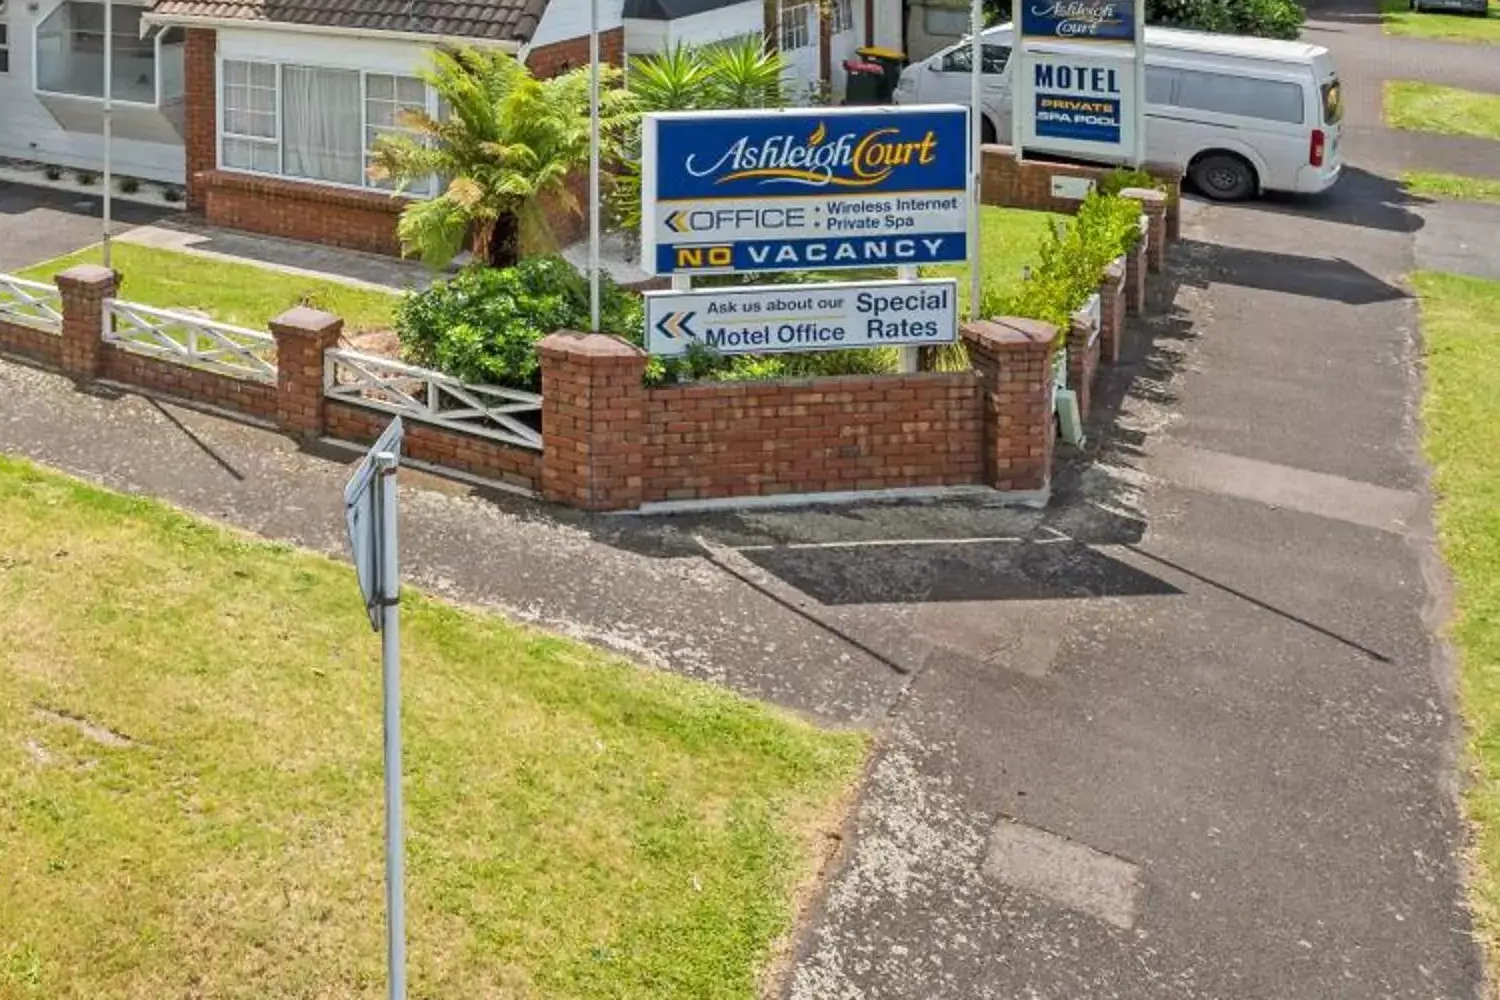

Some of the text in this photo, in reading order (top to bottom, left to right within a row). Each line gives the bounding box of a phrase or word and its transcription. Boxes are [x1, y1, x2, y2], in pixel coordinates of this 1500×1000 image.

[1031, 0, 1117, 23] Ashleigh
[1056, 19, 1098, 37] Court
[1035, 63, 1120, 93] MOTEL
[1041, 98, 1113, 113] PRIVATE
[1037, 111, 1120, 127] SPA POOL
[686, 128, 938, 186] Ashleigh Court
[827, 198, 958, 214] Wireless Internet
[689, 208, 805, 231] OFFICE
[827, 214, 915, 230] Private Spa
[678, 238, 944, 267] NO VACANCY
[707, 298, 845, 314] Ask us about our
[856, 289, 948, 316] Special
[705, 322, 845, 347] Motel Office
[867, 318, 938, 339] Rates
